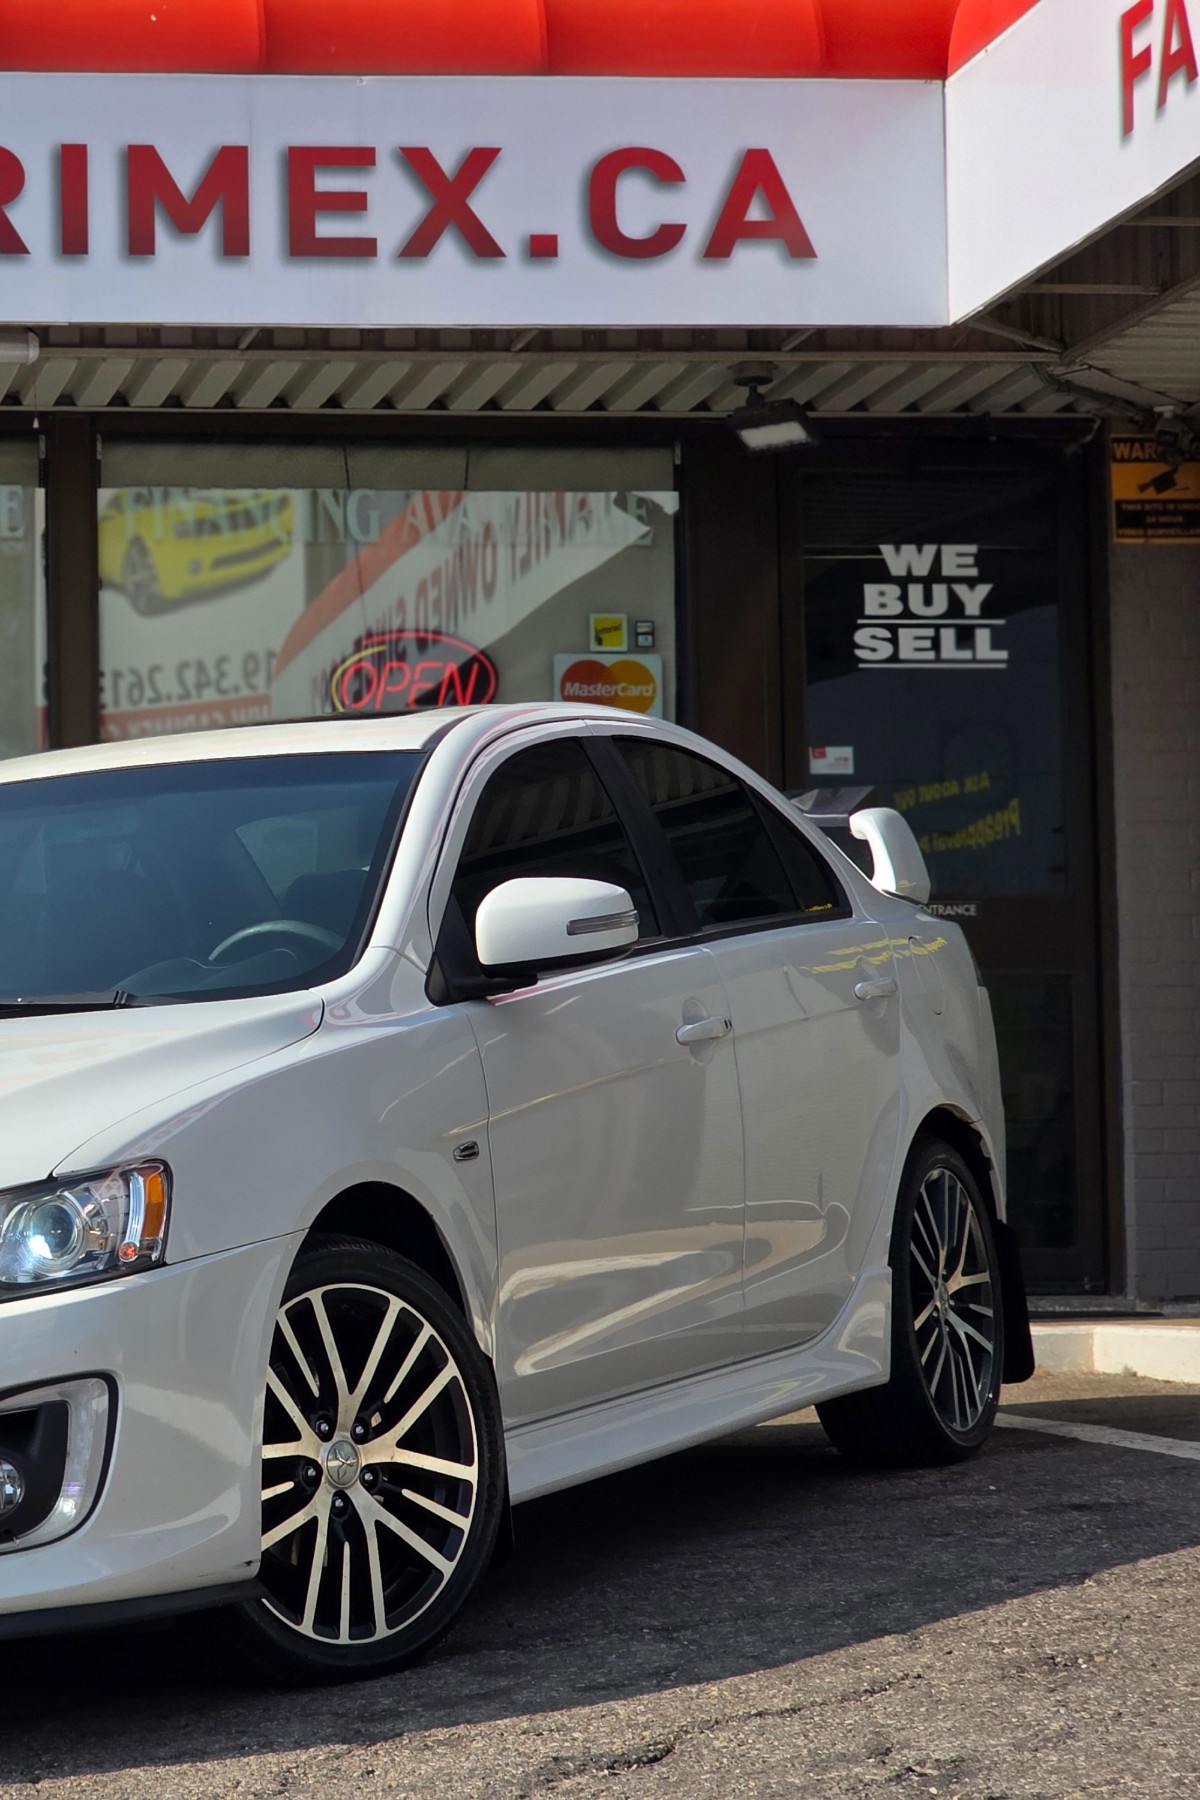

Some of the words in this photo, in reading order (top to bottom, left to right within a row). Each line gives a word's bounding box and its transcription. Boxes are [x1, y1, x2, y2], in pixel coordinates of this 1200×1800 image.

[879, 544, 979, 577] WE
[863, 584, 993, 616] BUY
[853, 627, 1009, 661] SELL
[341, 662, 479, 709] OPEN
[564, 682, 654, 697] MasterCard
